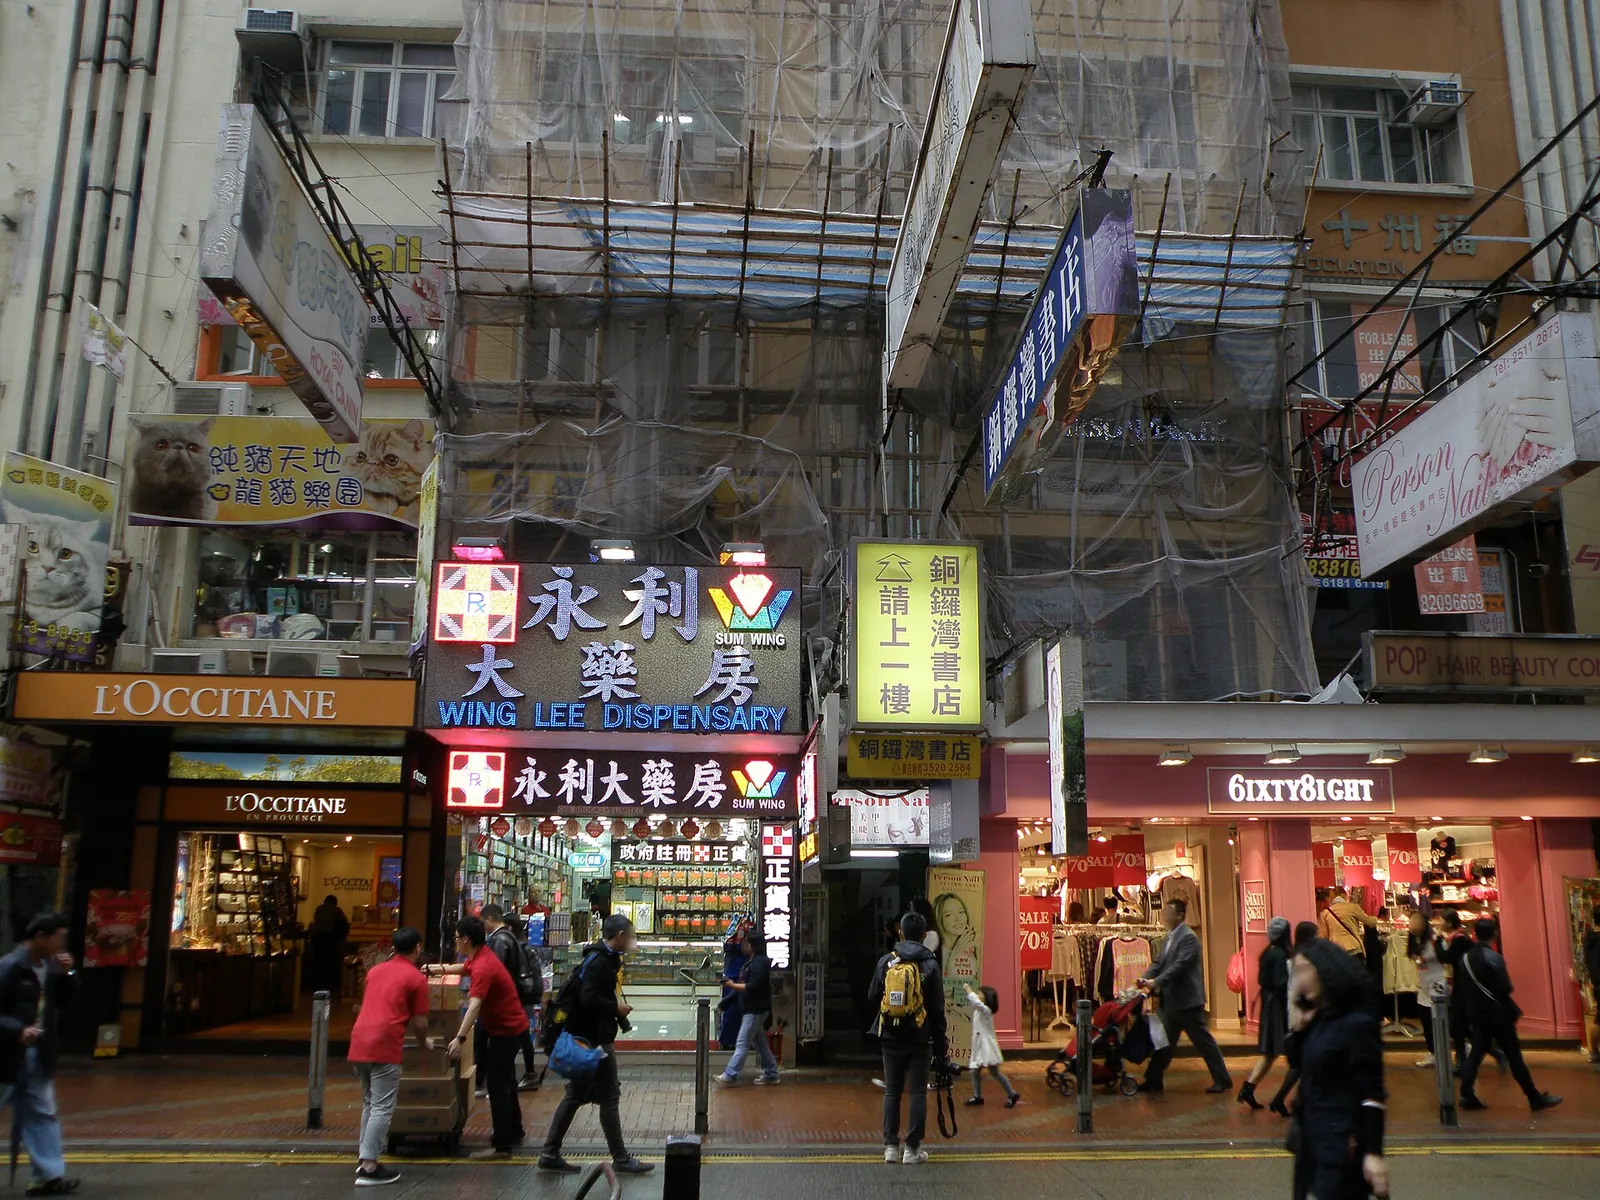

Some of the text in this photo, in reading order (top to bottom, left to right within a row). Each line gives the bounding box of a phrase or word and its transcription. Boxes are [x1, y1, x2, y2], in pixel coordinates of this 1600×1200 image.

[1359, 332, 1379, 345] FOR
[1493, 321, 1560, 376] Tel: 2511 2873
[987, 236, 1081, 480] 銅鑼灣書店
[1360, 373, 1420, 390] 826669
[208, 443, 342, 475] 純貓天地
[235, 476, 363, 508] 龍貓樂園
[1362, 440, 1455, 523] Person
[1426, 453, 1491, 536] Nail
[1441, 547, 1474, 561] LEASE
[1322, 578, 1350, 588] 6181
[1428, 567, 1468, 583] 出租
[522, 566, 699, 641] 永利
[1420, 593, 1484, 612] 82096669
[47, 624, 92, 644] 8858
[715, 632, 785, 646] SUM WING
[929, 555, 961, 716] 銅鑼灣書店
[880, 585, 911, 715] 請上一樓
[1386, 645, 1427, 676] POP
[1438, 656, 1481, 676] HAIR
[1490, 657, 1559, 678] BEAUTY
[462, 641, 758, 706] 大藥房
[93, 680, 337, 720] L'OCCITANE
[438, 701, 788, 731] WING LEE DISPENSARY
[859, 739, 971, 760] 銅鑼灣書店
[922, 762, 946, 772] 3520
[949, 763, 971, 772] 2584
[511, 756, 728, 808] 永利大藥房
[1229, 774, 1374, 802] 6IXTY8IGHT
[225, 793, 346, 814] L'OCCITANE
[733, 798, 785, 809] SUM WING
[266, 814, 323, 822] PROVENCE
[620, 844, 748, 862] 政府註冊 正貨
[1114, 852, 1144, 868] 70%
[1343, 855, 1373, 866] SALE
[1389, 850, 1418, 865] 70%
[764, 858, 791, 969] 正貨藥房
[1020, 911, 1049, 924] SALE
[1020, 931, 1049, 950] 70%
[804, 965, 817, 1035] 銅鑼灣書店
